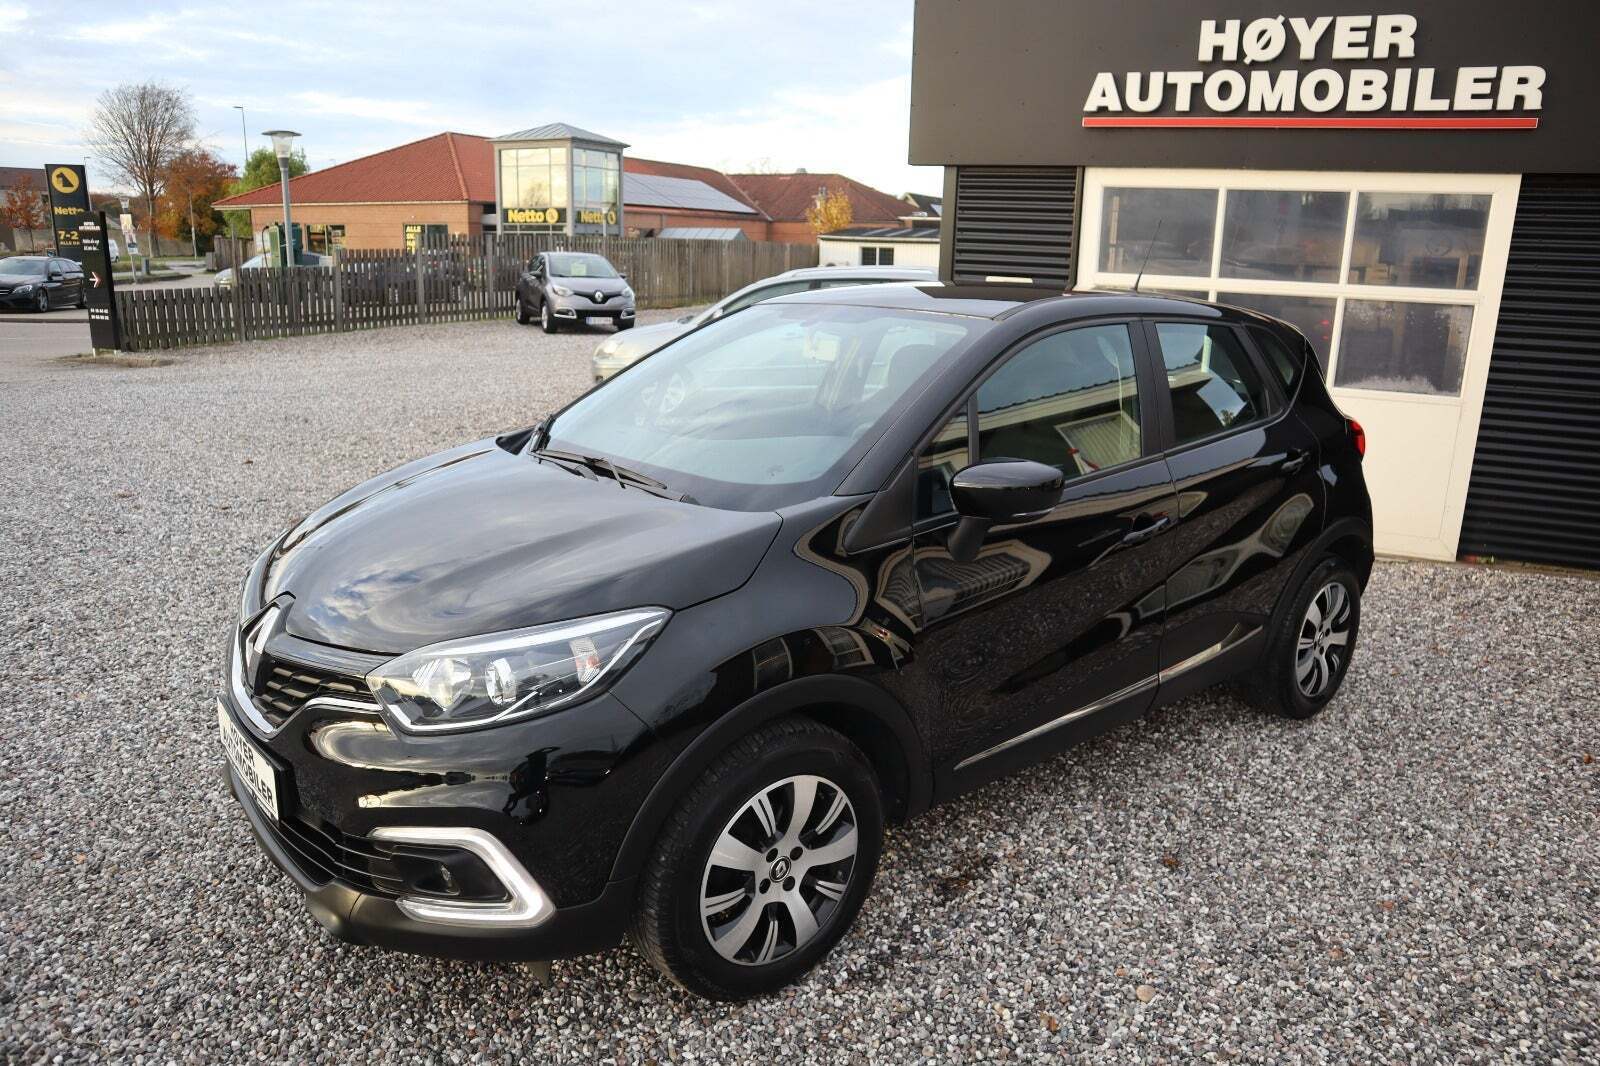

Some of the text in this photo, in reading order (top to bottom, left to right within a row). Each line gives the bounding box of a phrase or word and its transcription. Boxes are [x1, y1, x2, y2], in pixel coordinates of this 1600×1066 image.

[1197, 14, 1419, 65] HØYER
[1082, 65, 1547, 113] AUTOMOBILER
[508, 209, 545, 223] Netto
[580, 210, 604, 224] Nett
[58, 230, 79, 240] 7-2
